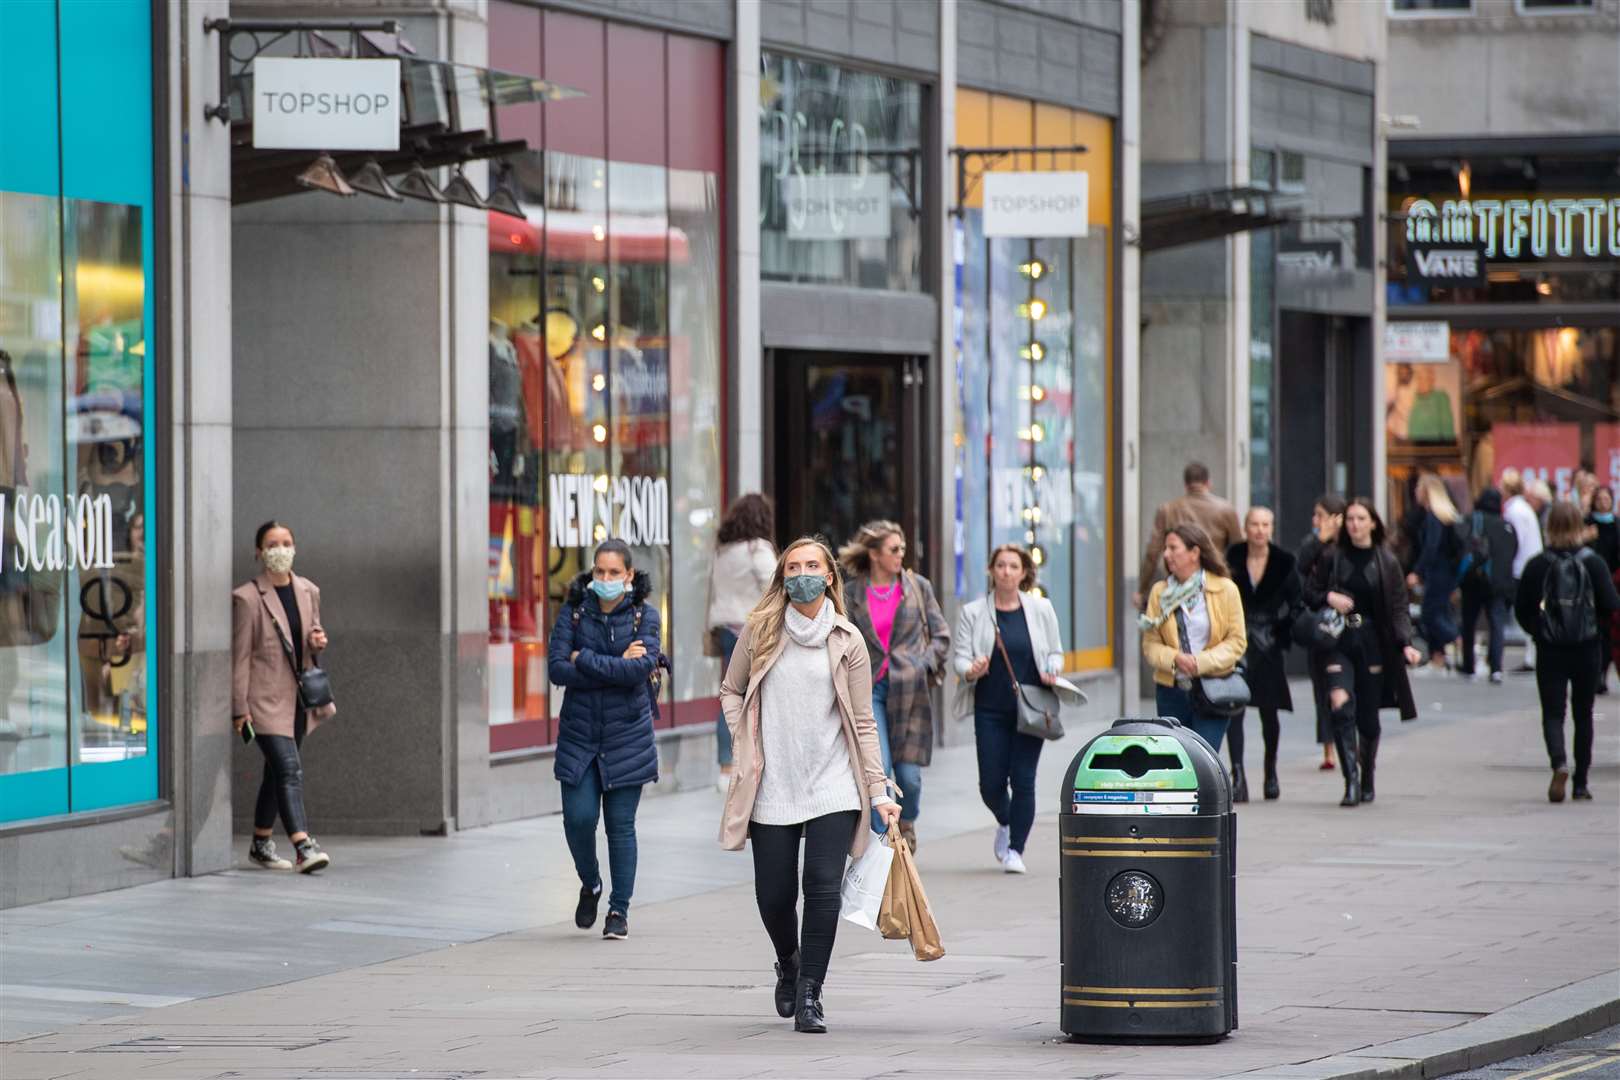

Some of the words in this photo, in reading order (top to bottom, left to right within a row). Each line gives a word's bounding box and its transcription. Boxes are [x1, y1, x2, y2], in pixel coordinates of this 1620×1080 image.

[262, 91, 390, 115] TOPSHOP
[991, 194, 1081, 214] TOPSHOP
[1414, 249, 1479, 278] VANS
[549, 473, 595, 548] NEW
[14, 493, 115, 572] season
